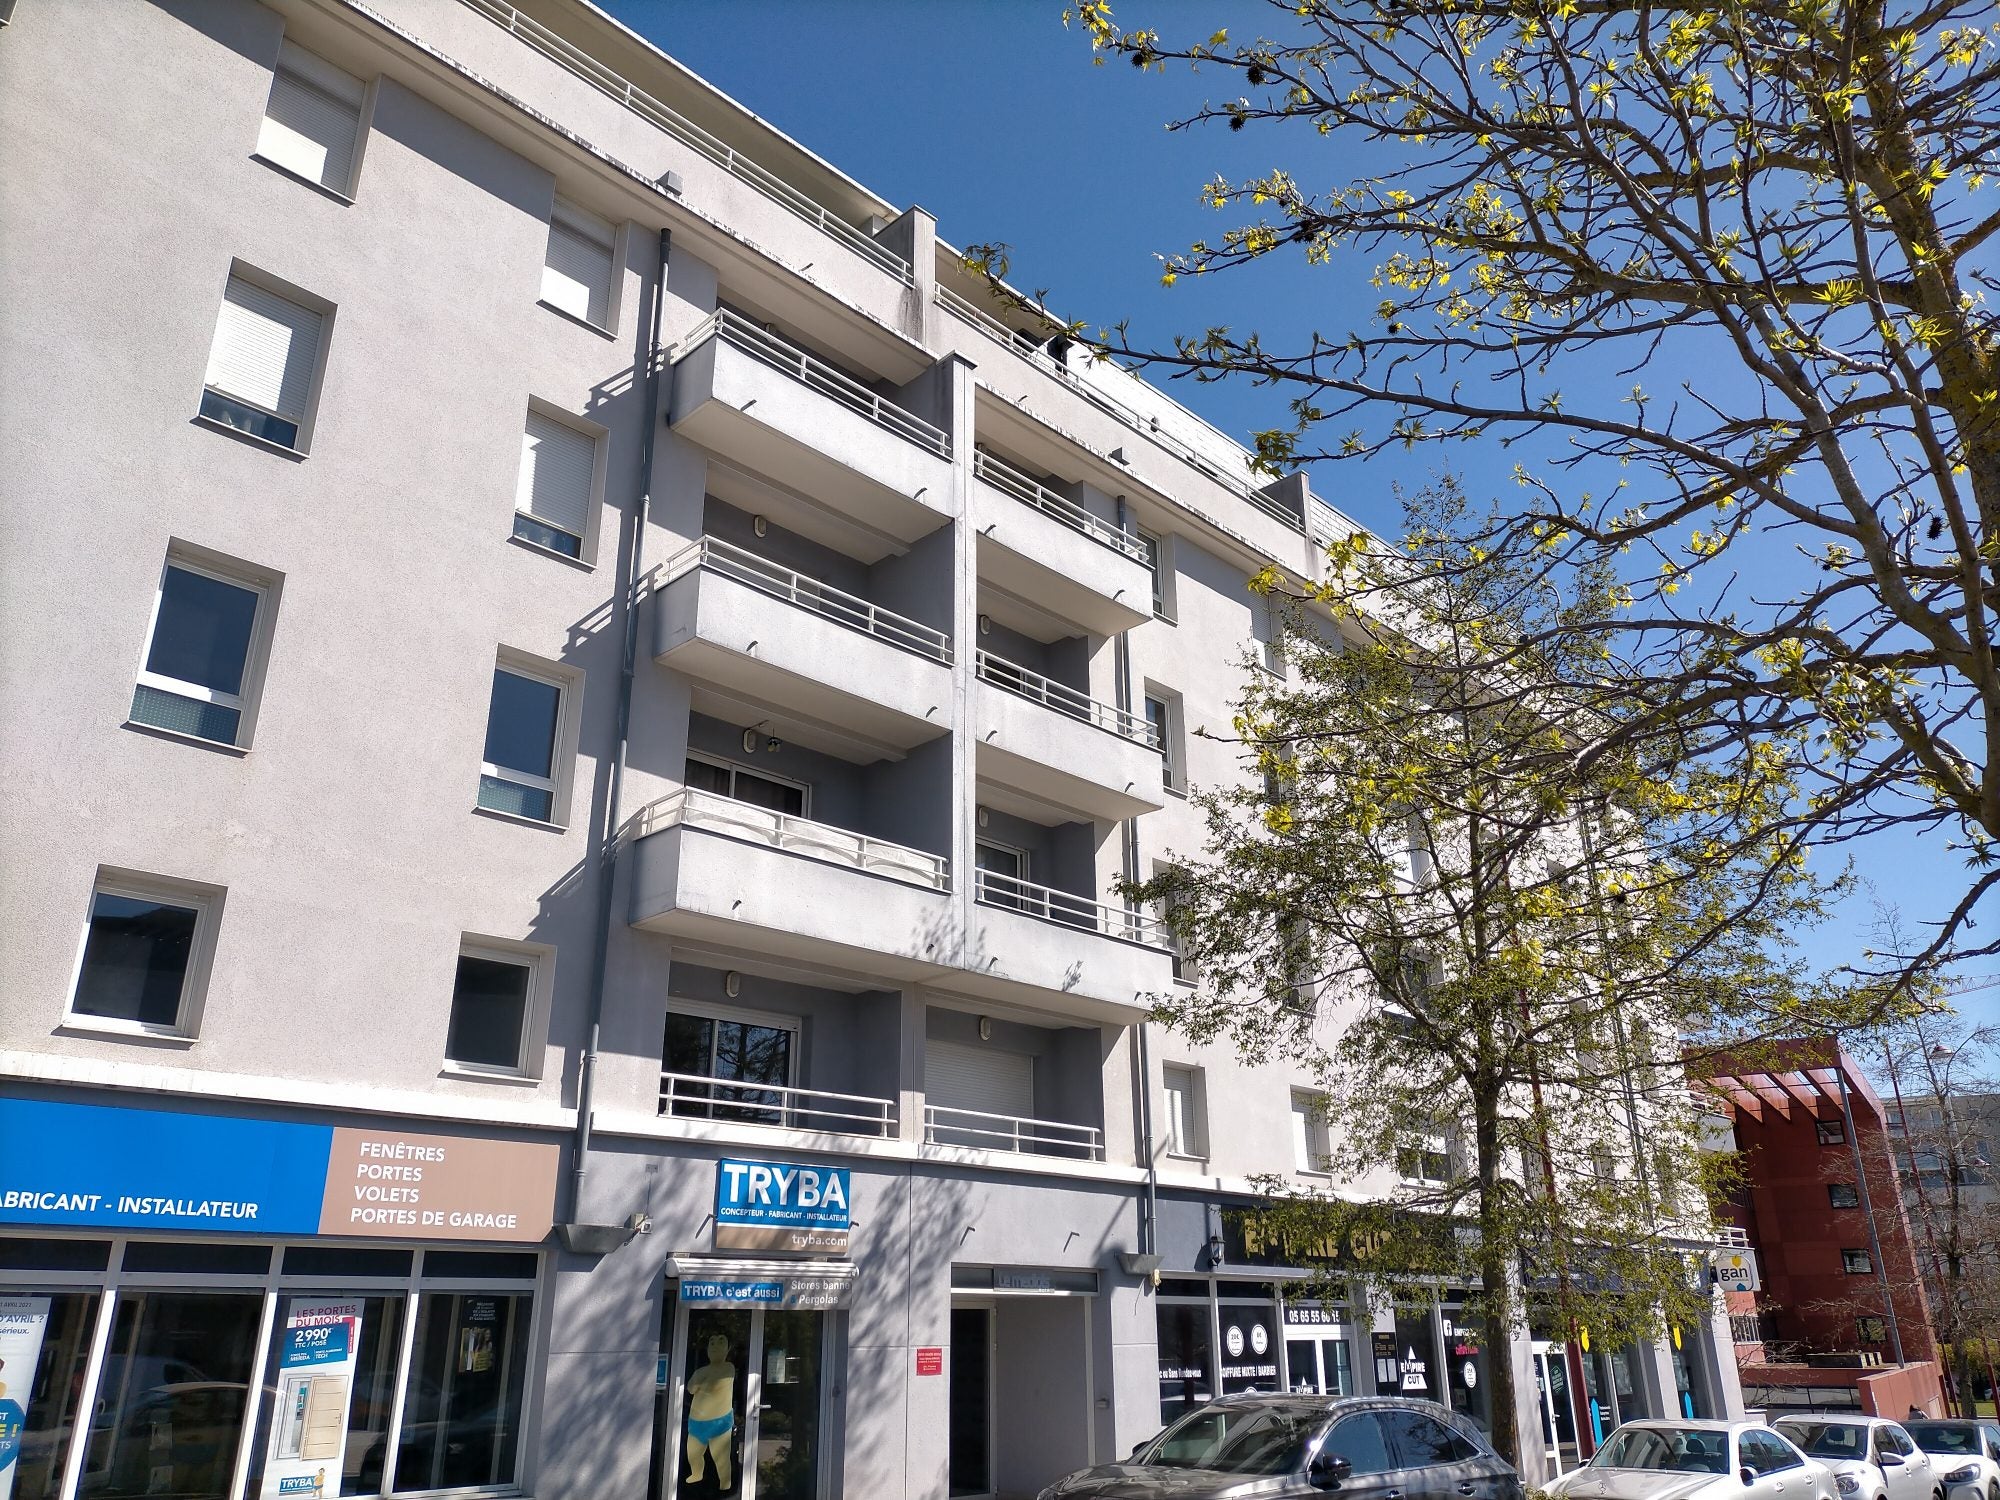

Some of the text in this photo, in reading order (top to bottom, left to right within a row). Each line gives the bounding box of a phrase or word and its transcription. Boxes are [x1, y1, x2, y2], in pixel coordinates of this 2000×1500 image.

[360, 1142, 446, 1162] FENÊTRES
[357, 1164, 423, 1182] PORTES
[723, 1163, 847, 1209] TRYBA
[354, 1186, 419, 1203] VOLETS
[0, 1190, 101, 1211] BRICANT
[117, 1197, 258, 1218] INSTALLATEUR
[350, 1207, 517, 1229] PORTES DE GARAGE
[721, 1207, 764, 1217] CONCEPTEUR
[768, 1210, 803, 1219] FABRICANT
[806, 1212, 847, 1222] INSTALLATEUR
[792, 1233, 847, 1247] tryba.com
[1720, 1267, 1748, 1281] gan
[684, 1285, 780, 1298] TRYBA c'est aussi
[791, 1280, 820, 1290] Stores
[799, 1294, 839, 1305] Pergolas
[296, 1304, 356, 1318] LES PORTES
[1289, 1310, 1298, 1322] 05
[1300, 1310, 1309, 1322] 65
[1311, 1310, 1320, 1322] 55
[296, 1315, 340, 1328] DU MOIS
[0, 1327, 30, 1335] érieux,
[1220, 1366, 1241, 1378] OIFFURE
[1408, 1375, 1420, 1385] CUT
[281, 1478, 312, 1488] TRYBA
